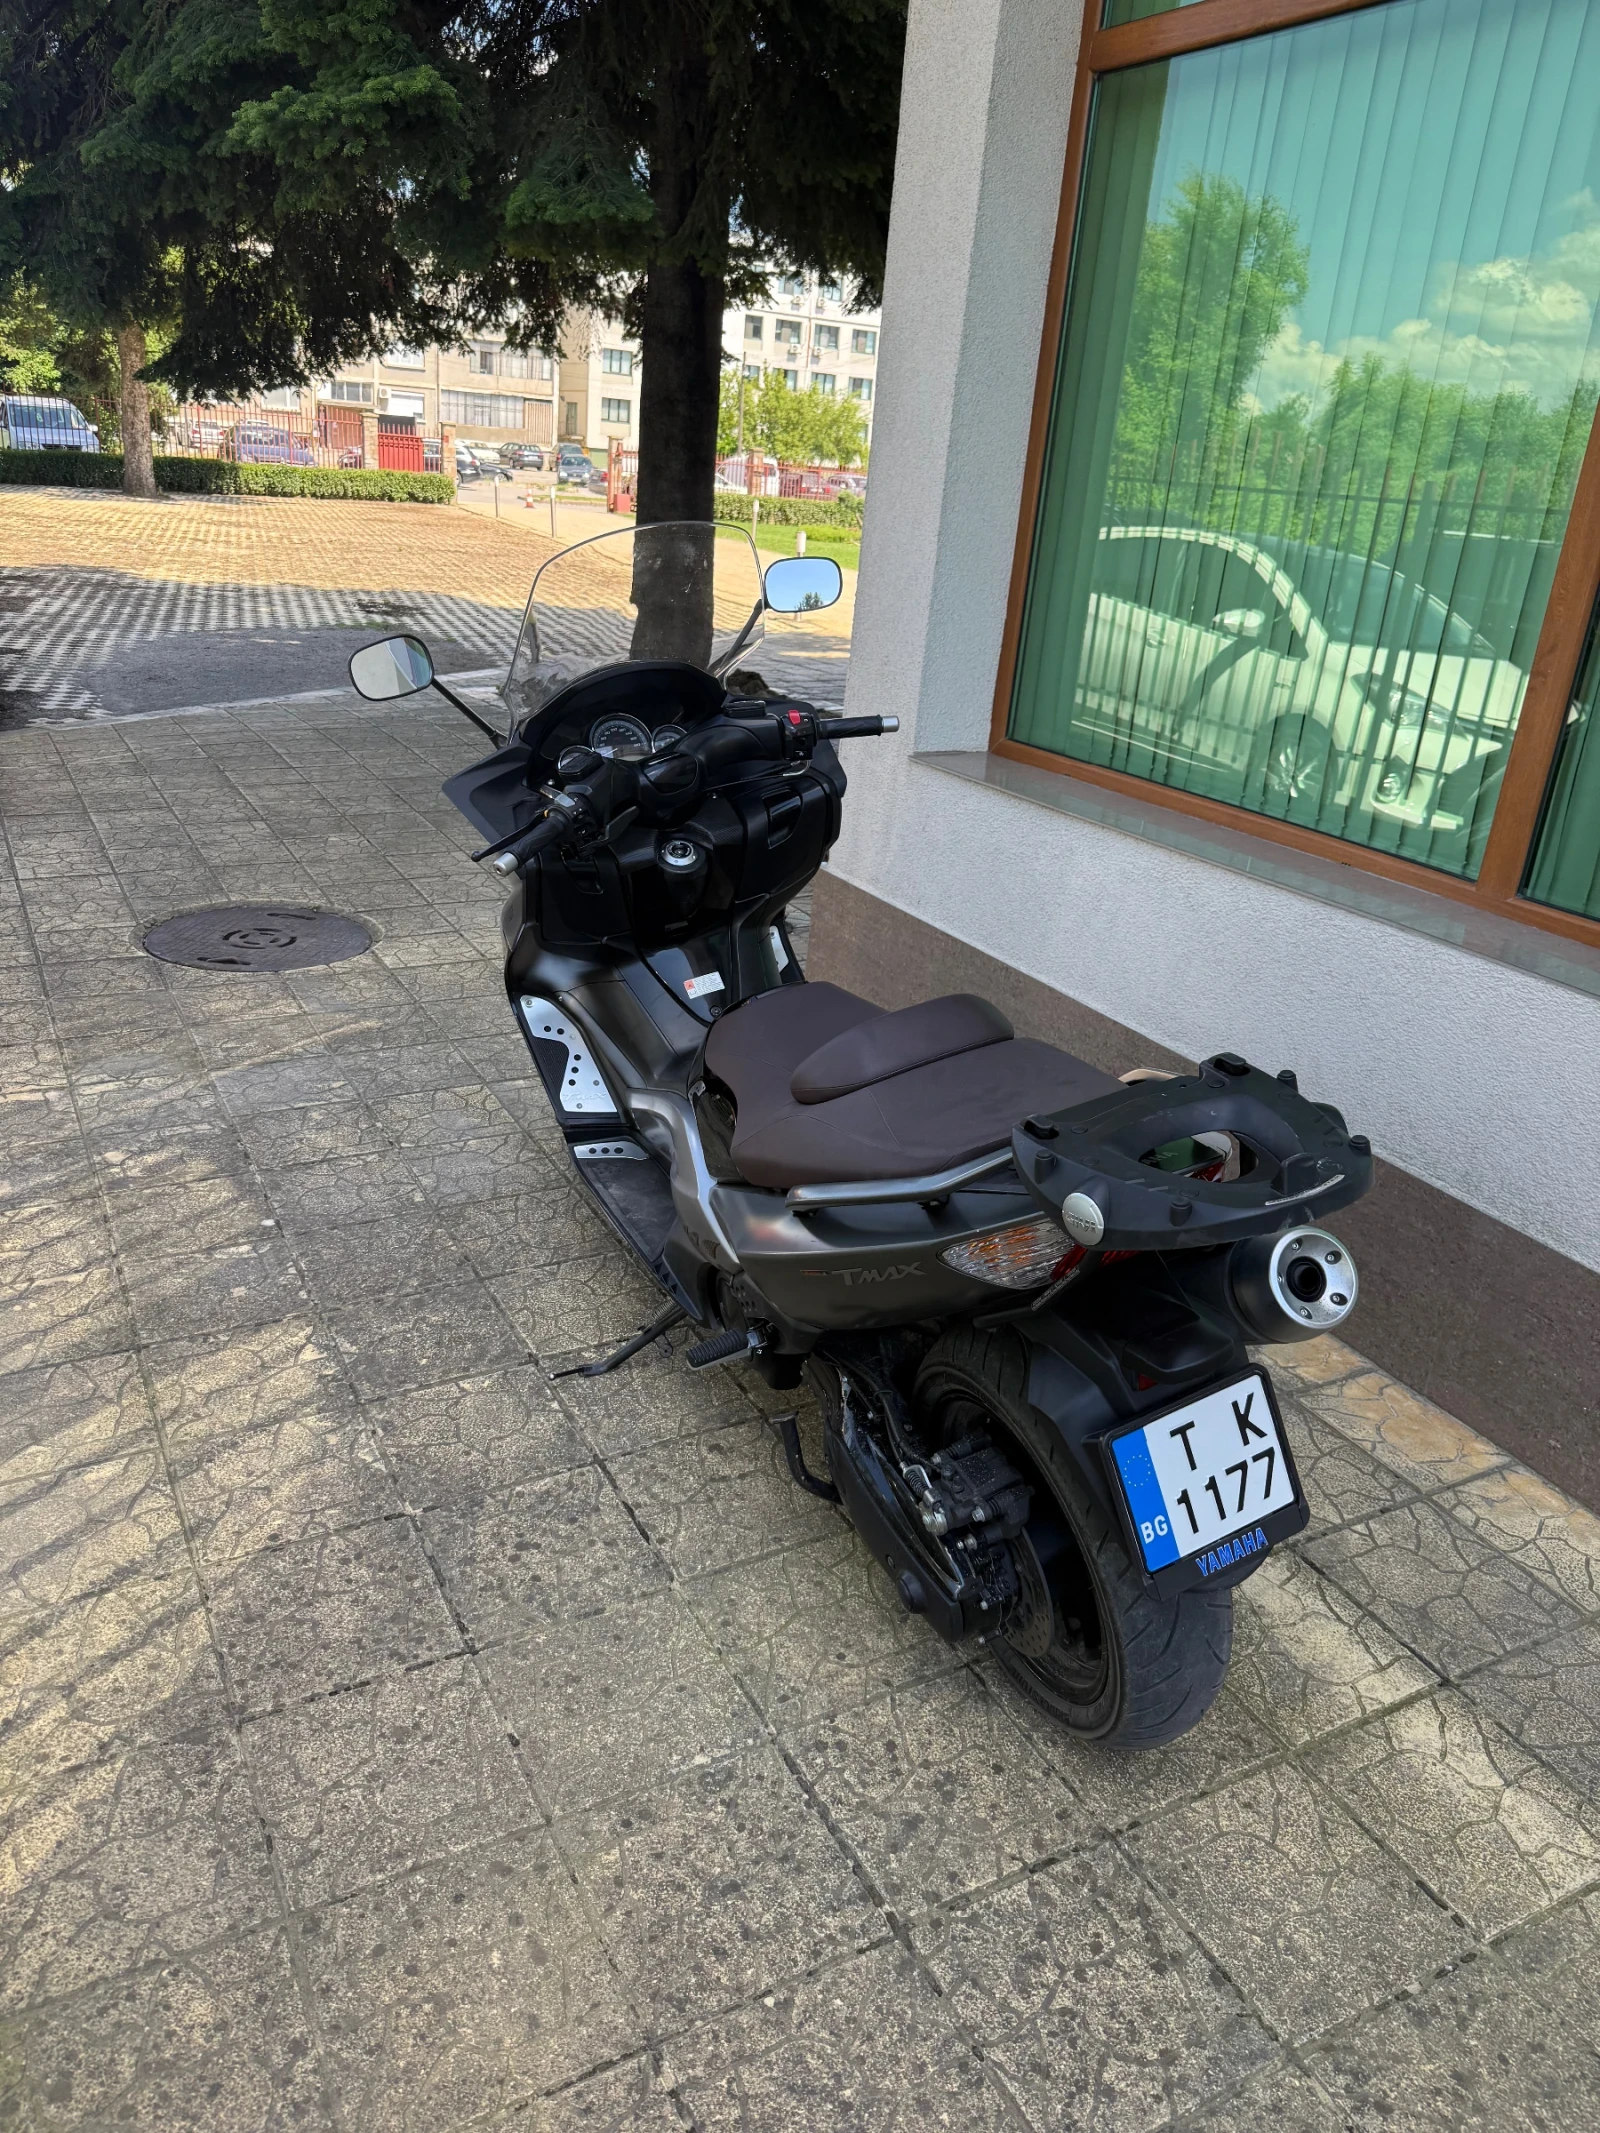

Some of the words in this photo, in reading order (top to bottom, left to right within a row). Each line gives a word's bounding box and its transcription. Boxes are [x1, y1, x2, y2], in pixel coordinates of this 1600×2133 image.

[831, 1261, 927, 1286] TMAX
[1169, 1420, 1198, 1472] T
[1231, 1391, 1268, 1447] K
[1176, 1446, 1275, 1535] 1177
[1140, 1514, 1169, 1545] BG
[1195, 1527, 1269, 1577] YAMAHA
